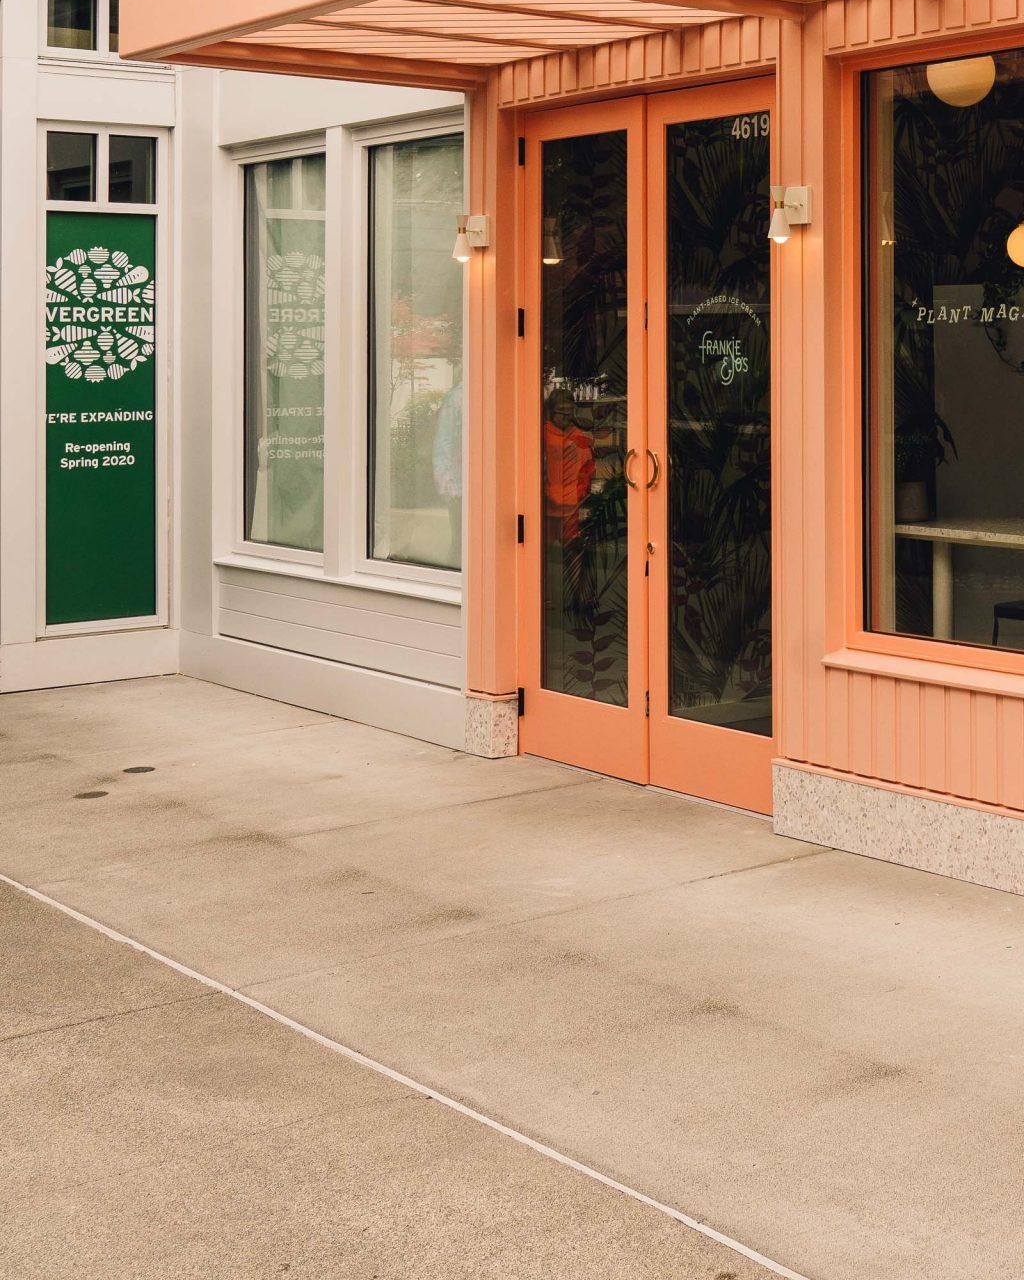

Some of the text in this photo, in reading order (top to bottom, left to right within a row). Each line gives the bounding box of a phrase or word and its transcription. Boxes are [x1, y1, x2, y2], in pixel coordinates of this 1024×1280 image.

[731, 114, 770, 140] 4619
[46, 306, 153, 323] VERGREEN
[686, 295, 761, 327] PLANT-BASED ICE CREAM
[916, 305, 972, 324] PLANT
[45, 410, 153, 424] E'RE EXPANDING
[65, 440, 131, 454] Re-opening
[60, 455, 135, 470] Spring 2020
